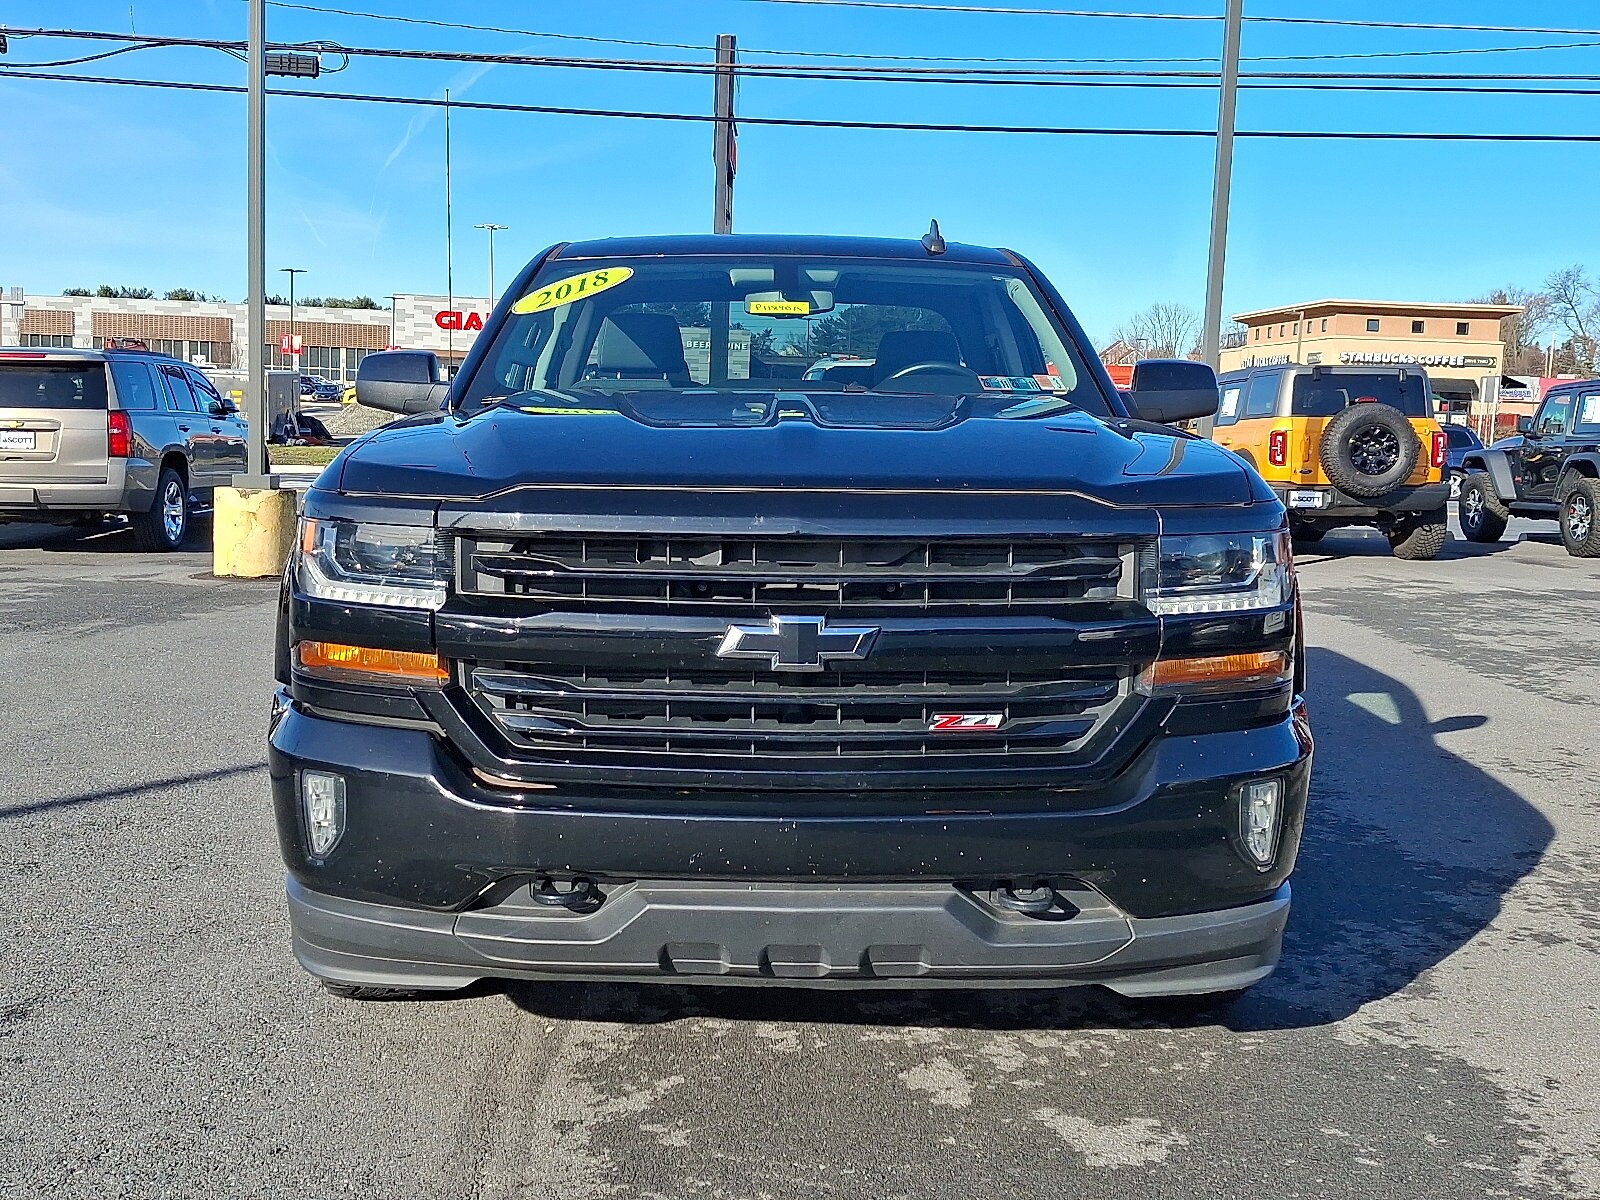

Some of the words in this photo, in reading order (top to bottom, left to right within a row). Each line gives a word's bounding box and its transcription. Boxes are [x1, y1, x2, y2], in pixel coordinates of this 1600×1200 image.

[536, 271, 609, 309] 2018
[435, 310, 491, 331] GIA
[1340, 352, 1416, 364] STARBUCKS
[1417, 355, 1465, 367] COFFEE
[929, 714, 1003, 730] Z71
